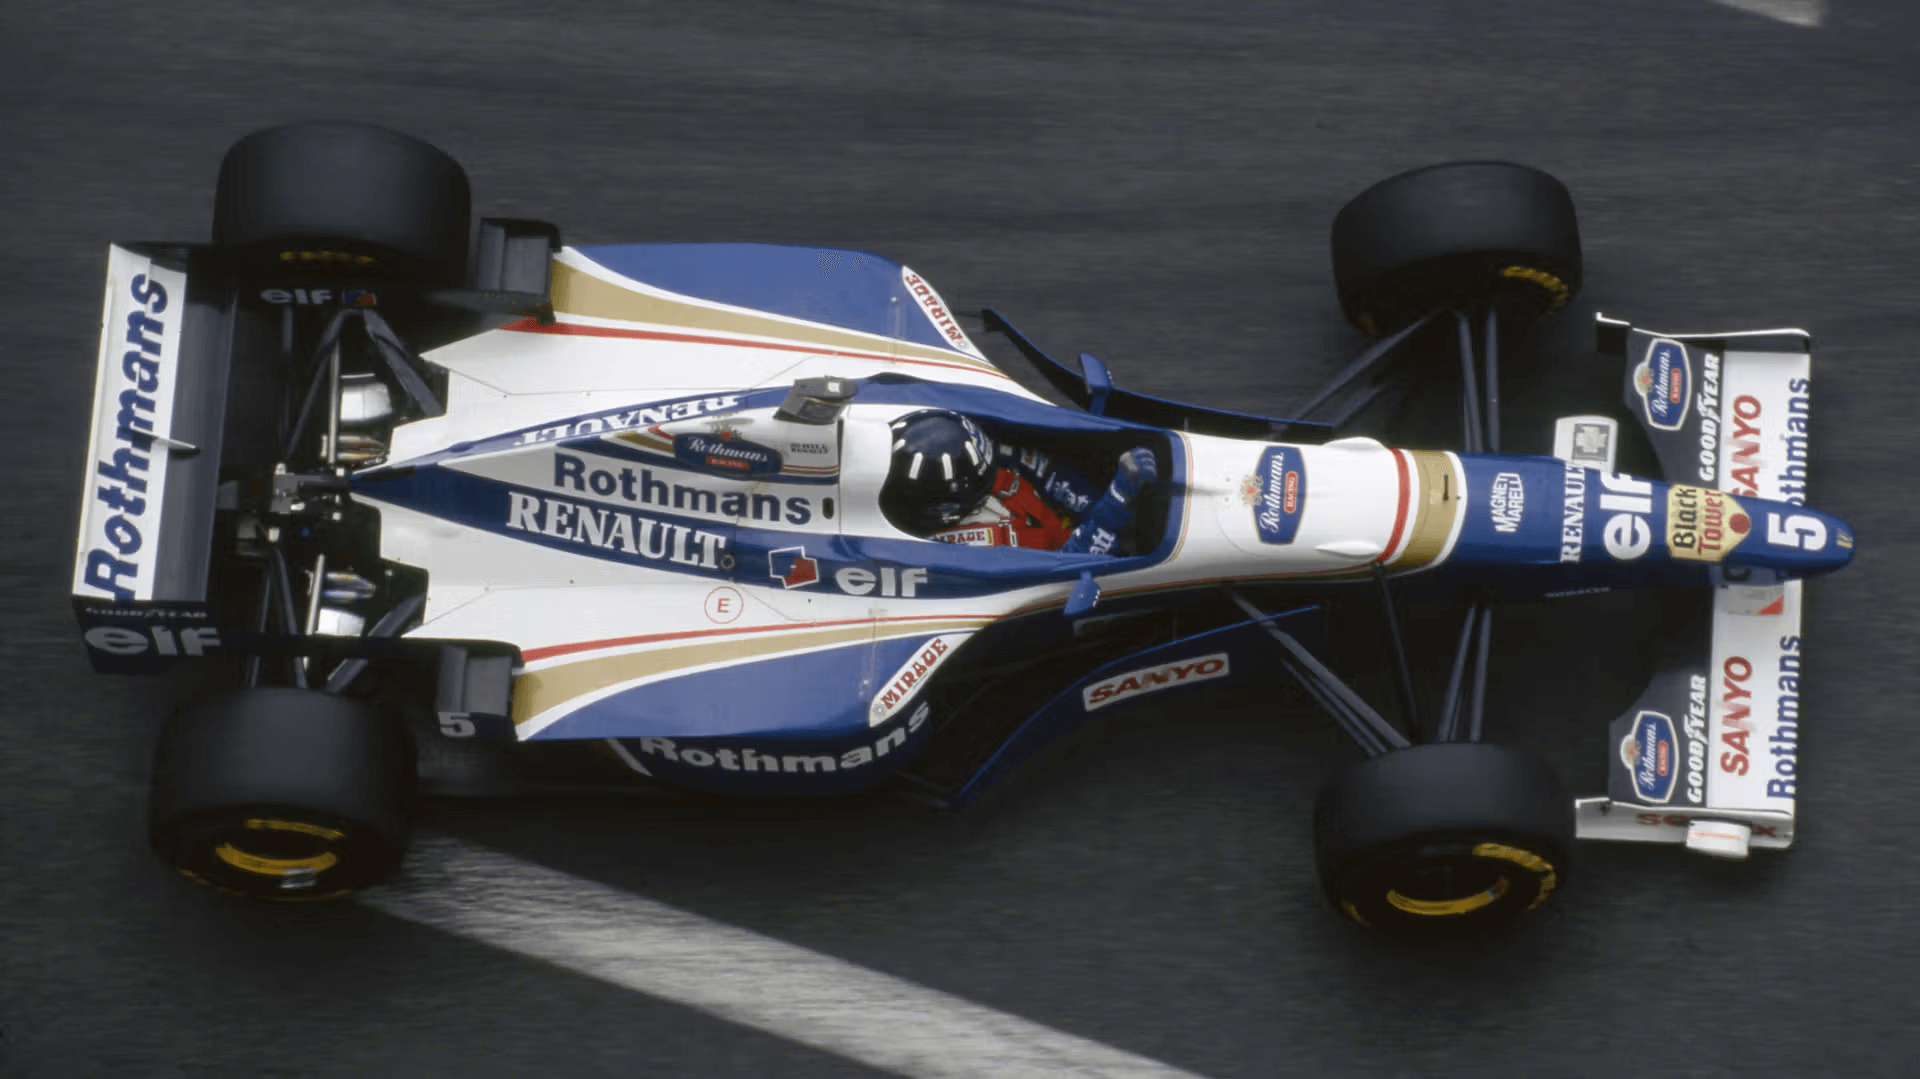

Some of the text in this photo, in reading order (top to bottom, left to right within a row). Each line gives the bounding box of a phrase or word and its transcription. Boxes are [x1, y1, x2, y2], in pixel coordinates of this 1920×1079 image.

[261, 288, 332, 304] elf
[905, 273, 963, 341] MIRAGE
[1652, 349, 1670, 418] Rothmans
[1697, 353, 1720, 482] GOODYEAR
[84, 273, 168, 600] Rothmans
[513, 394, 740, 446] RENAULT
[1779, 377, 1809, 506] othmans
[554, 452, 812, 524] Rothmans
[1258, 452, 1285, 534] Rothmans
[1600, 472, 1652, 561] elf
[1673, 487, 1697, 550] Black
[1697, 490, 1722, 555] Tower
[506, 491, 727, 570] RENAULT
[1767, 512, 1827, 551] 5
[717, 597, 731, 613] E
[835, 567, 929, 598] elf
[84, 625, 221, 656] elf
[881, 638, 949, 710] MIRAGE
[1088, 659, 1225, 704] SANYO
[1720, 656, 1752, 776] SANYO
[437, 711, 476, 737] 5
[640, 701, 929, 773] Rothmans
[1683, 674, 1708, 803] GOODYEAR
[1767, 635, 1801, 800] Rothmans
[1639, 722, 1657, 790] Rothmans
